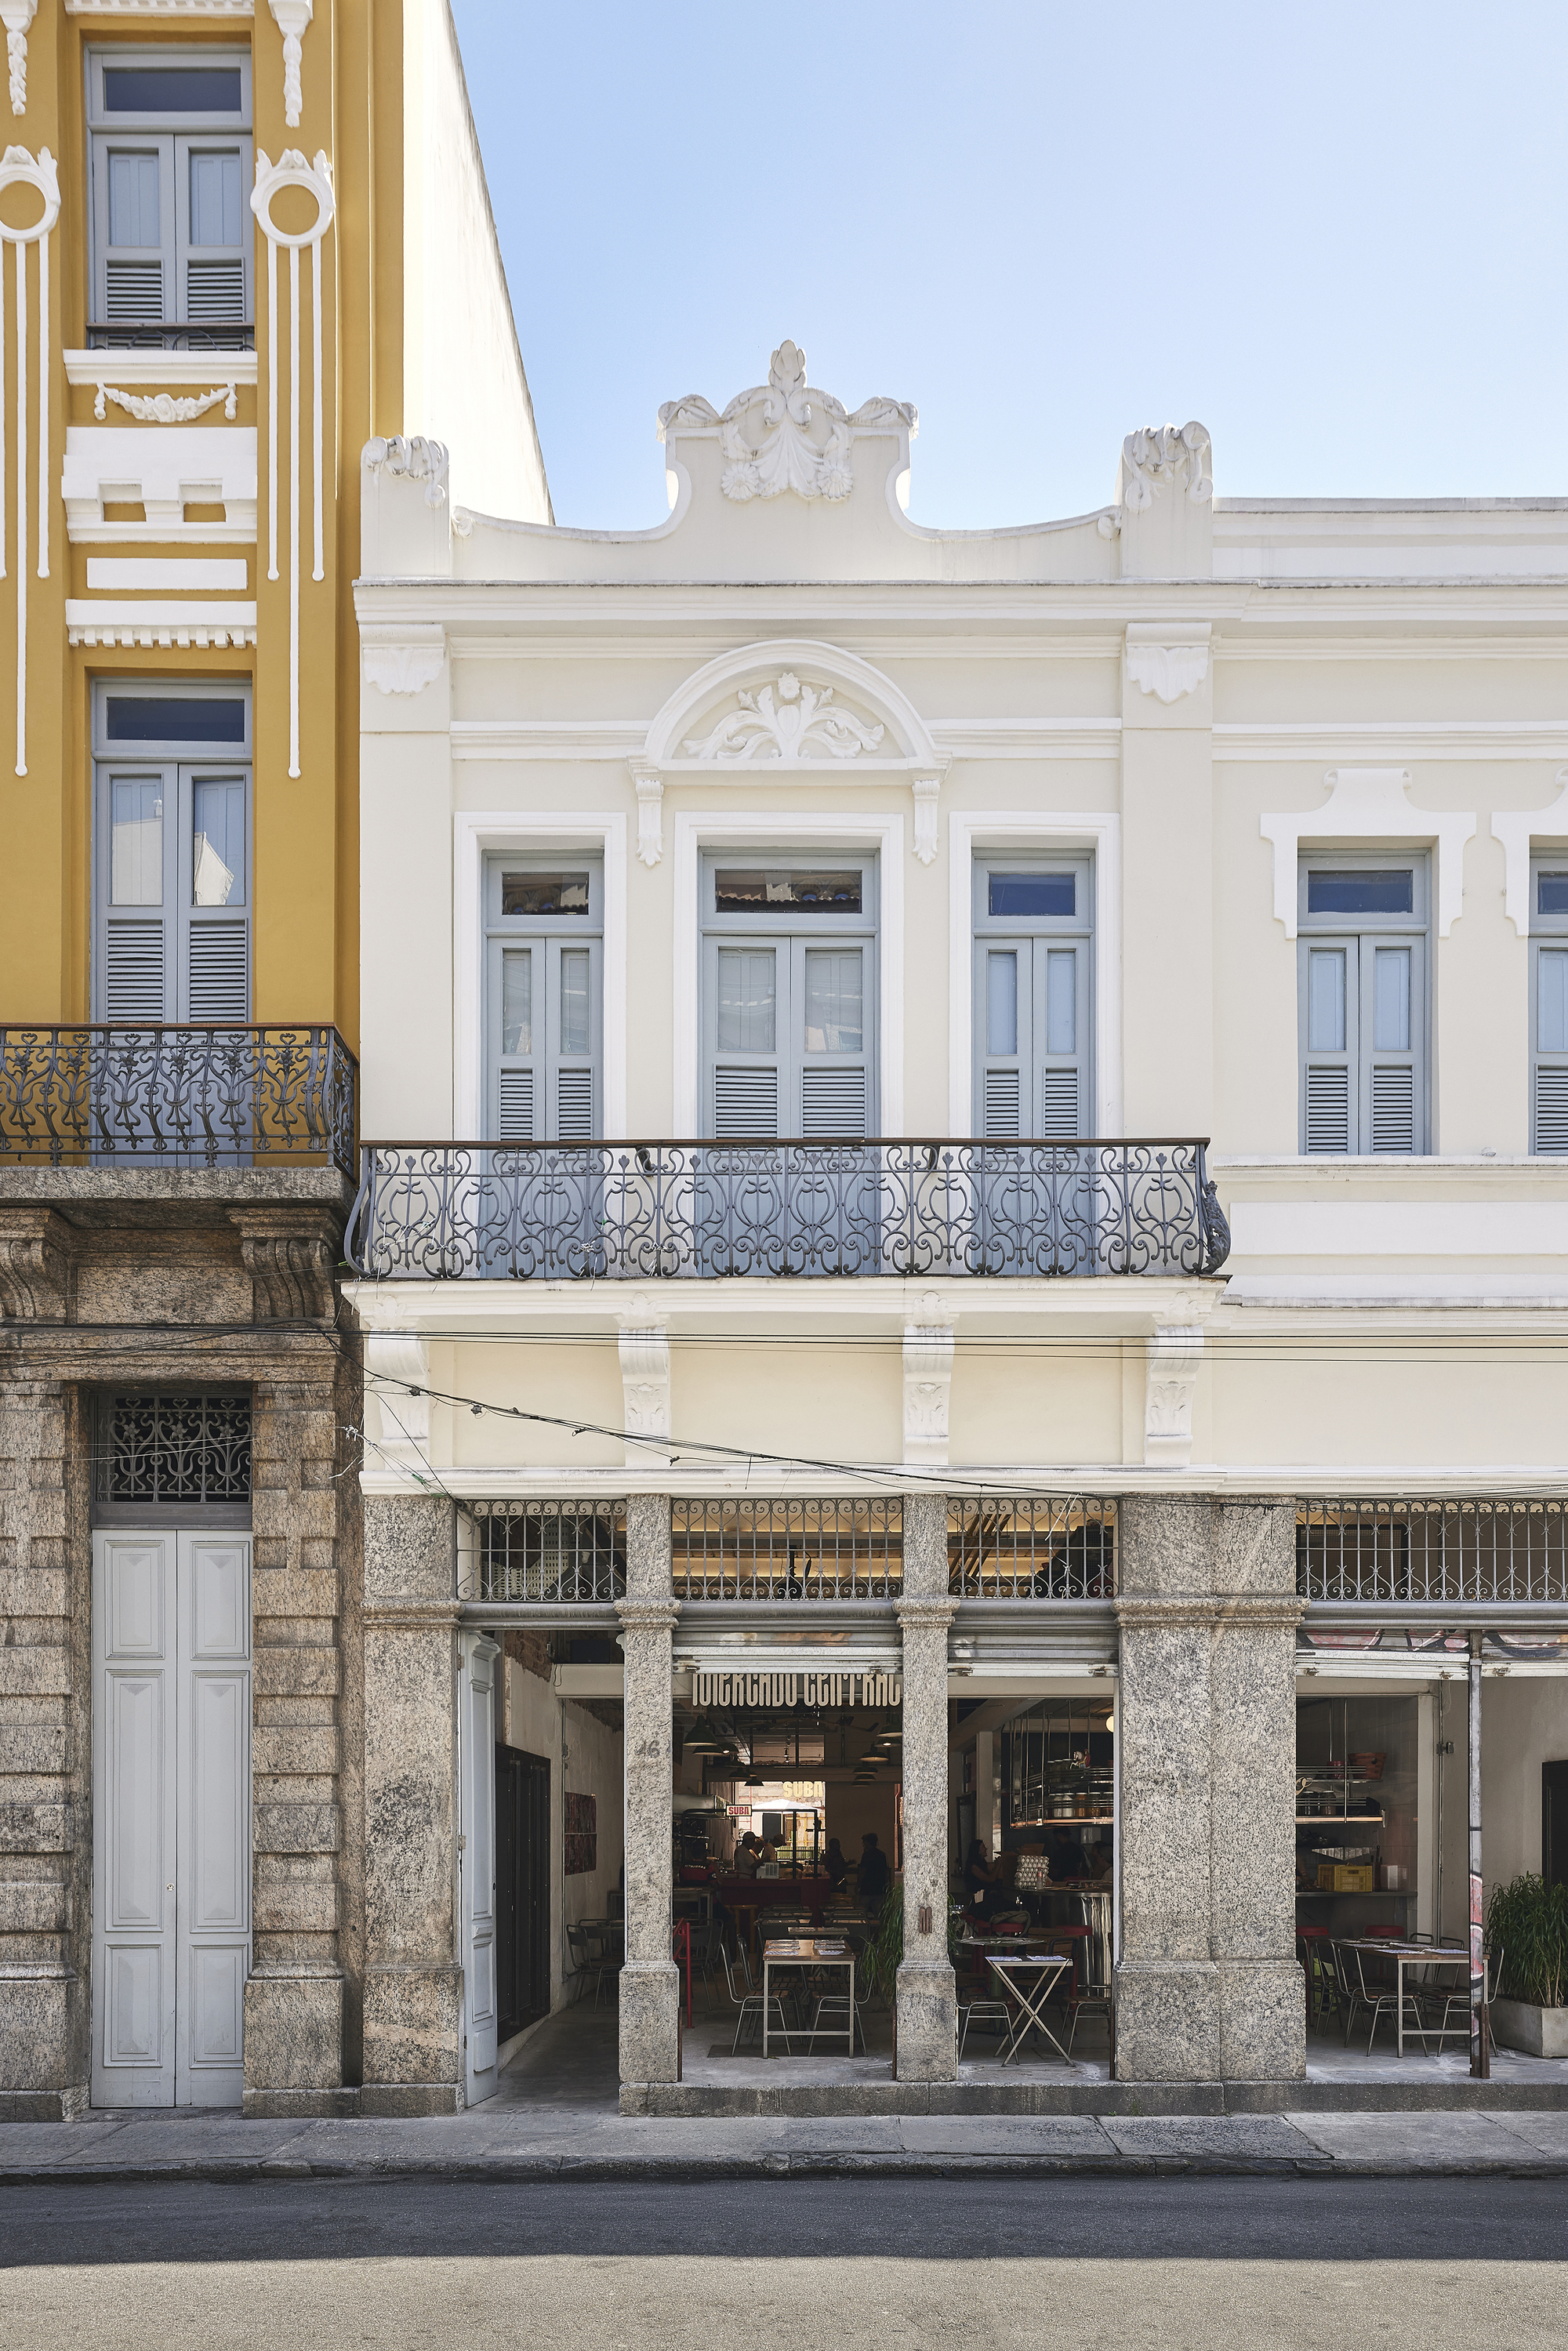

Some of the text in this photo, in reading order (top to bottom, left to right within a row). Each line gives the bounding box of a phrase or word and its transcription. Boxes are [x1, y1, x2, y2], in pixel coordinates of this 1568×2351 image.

[634, 1740, 660, 1758] 46
[782, 1781, 823, 1798] SUBA
[728, 1806, 750, 1815] SUBA
